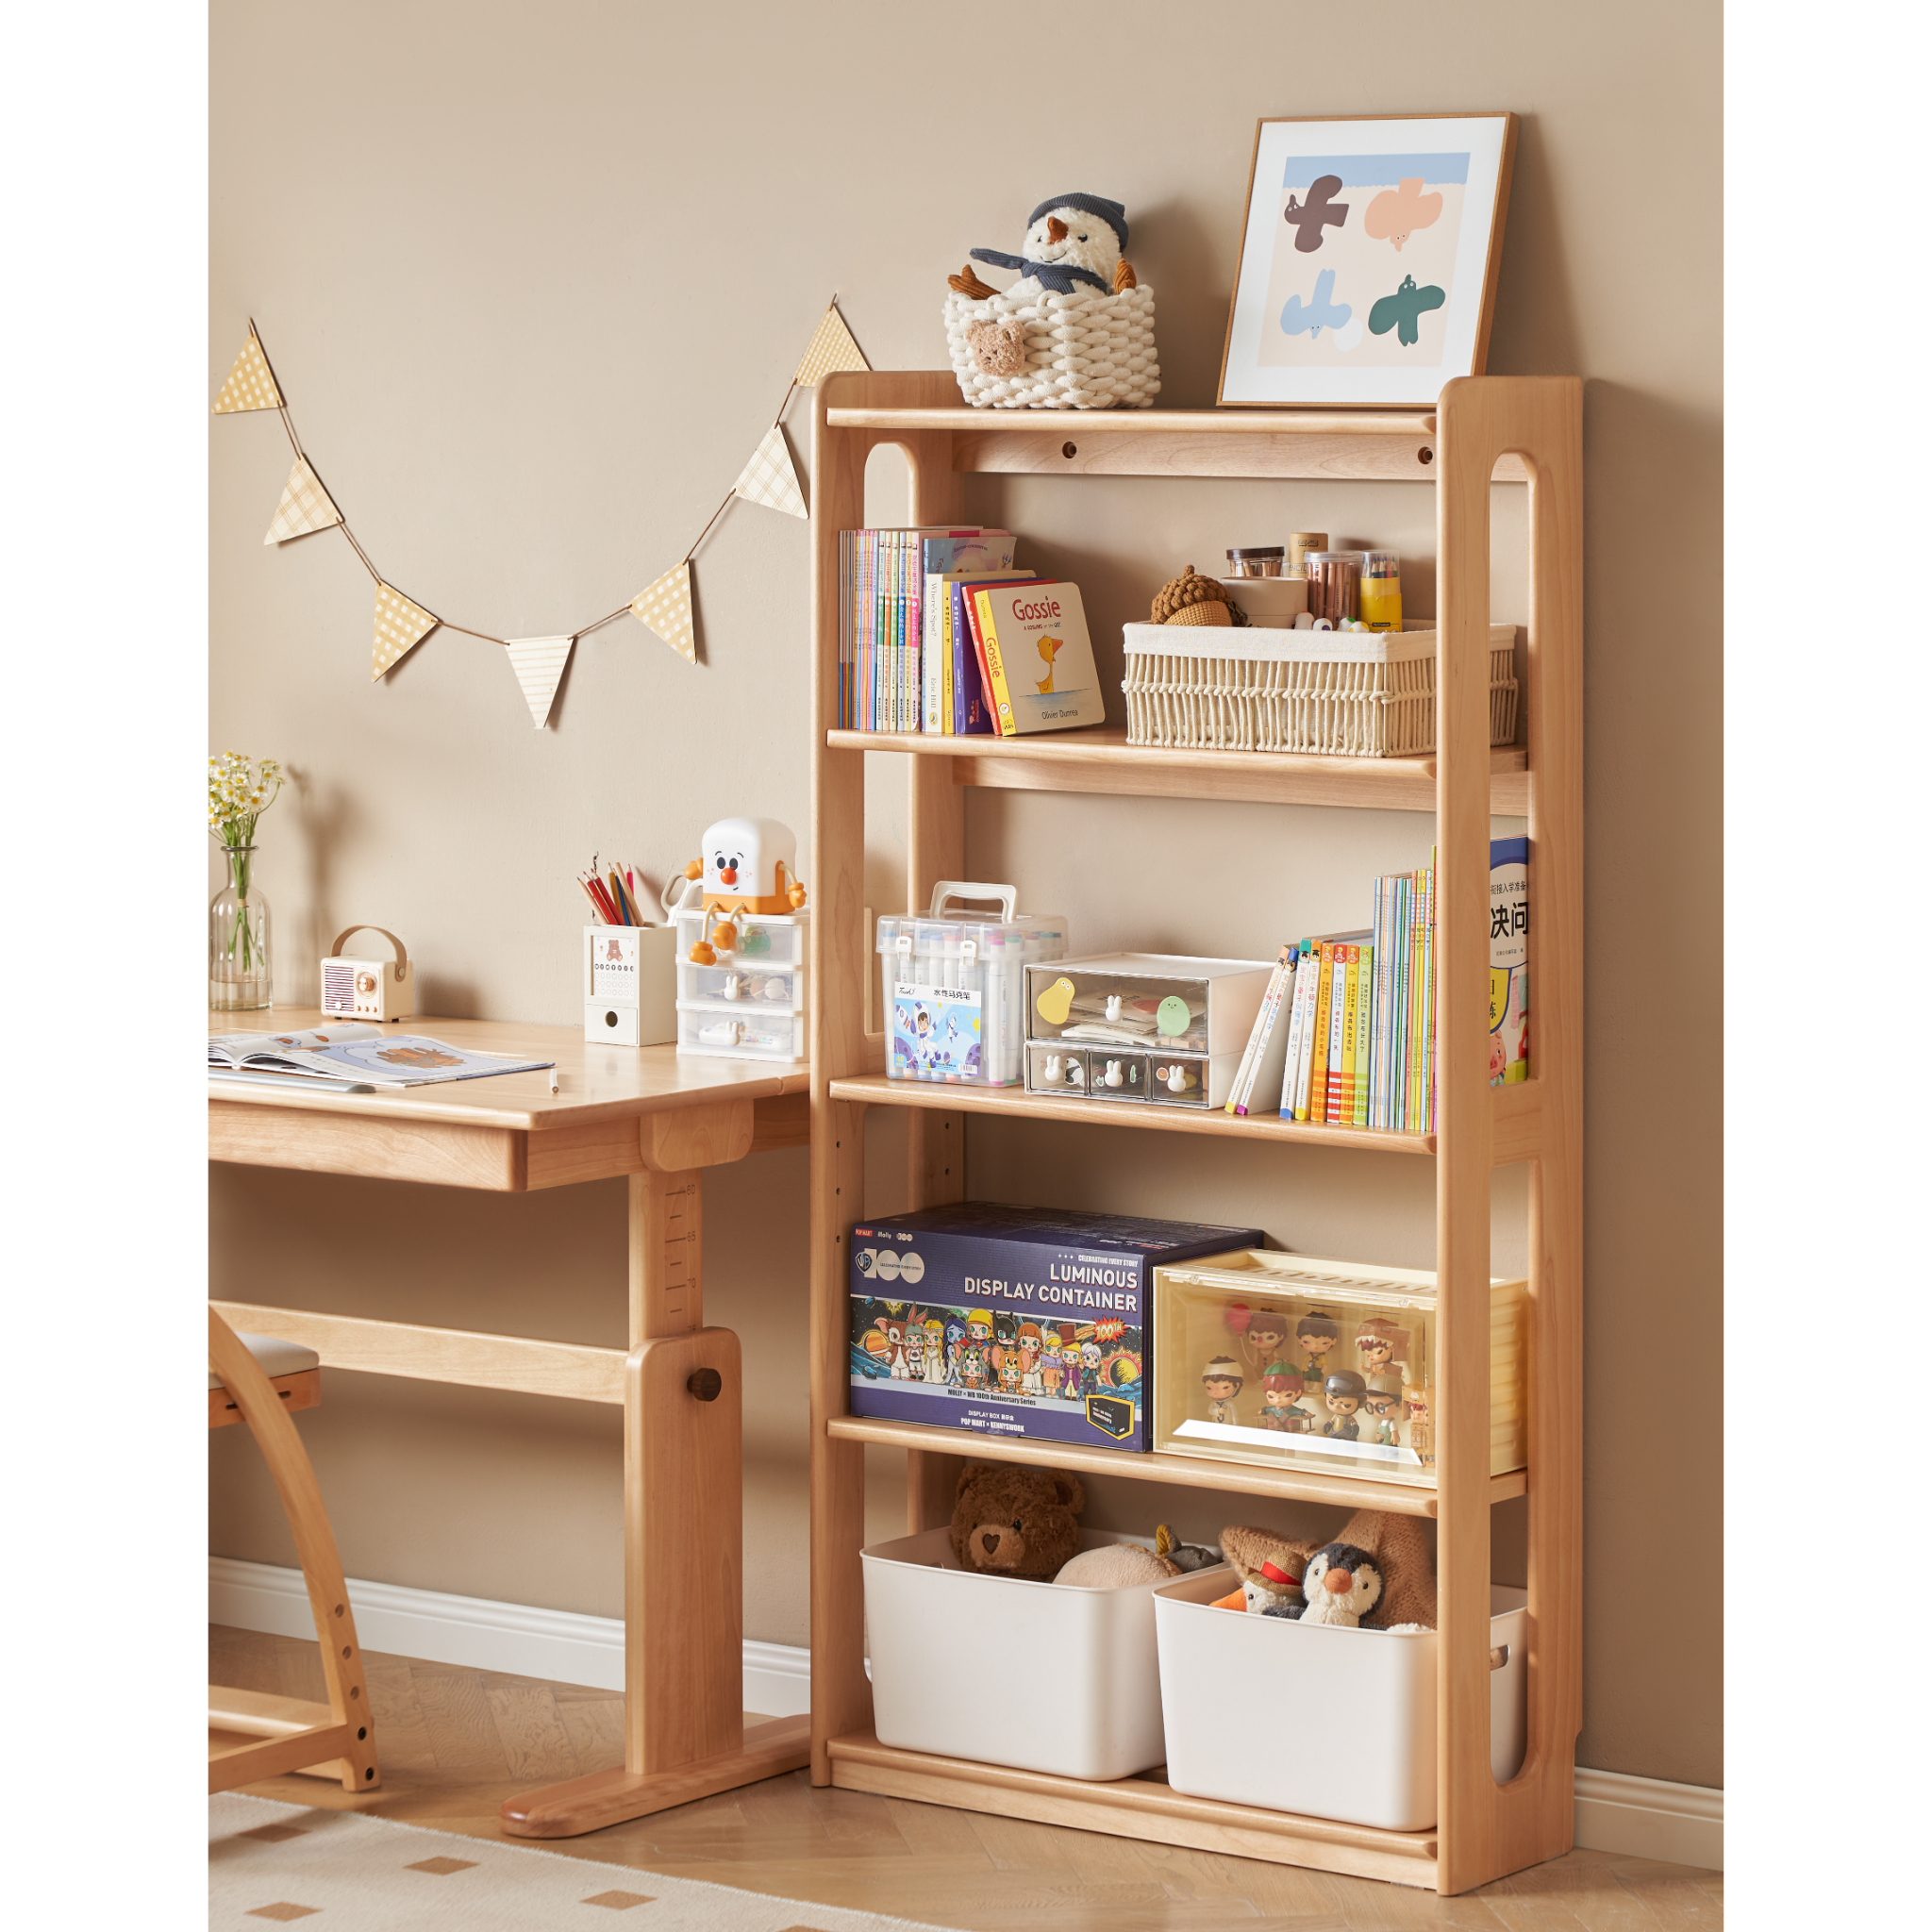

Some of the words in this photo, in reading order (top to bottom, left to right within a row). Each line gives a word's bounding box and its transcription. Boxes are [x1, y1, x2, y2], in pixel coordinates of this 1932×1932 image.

[1012, 595, 1061, 621] Gossie
[986, 637, 1002, 678] Gossie
[1041, 710, 1058, 720] Olivier
[1058, 709, 1078, 718] Dunrea
[1491, 880, 1526, 895] 衔接入学准备
[1491, 902, 1528, 940] 决问
[934, 989, 971, 1000] 水性马克笔
[687, 1184, 696, 1195] 60
[687, 1230, 696, 1242] 65
[1077, 1255, 1108, 1264] CELEBRATING
[687, 1277, 696, 1289] 70
[1050, 1263, 1139, 1291] LUMINOUS
[964, 1276, 1035, 1301] DISPLAY
[1039, 1286, 1138, 1313] CONTAINER
[1095, 1322, 1123, 1340] 100TH
[947, 1389, 962, 1397] MOLLY
[991, 1393, 1020, 1405] Anniversary
[1020, 1397, 1036, 1406] Series
[968, 1409, 989, 1418] DISPLAY
[960, 1417, 972, 1425] POP
[971, 1418, 986, 1427] MART
[990, 1422, 1025, 1432] KENNYSWORK
